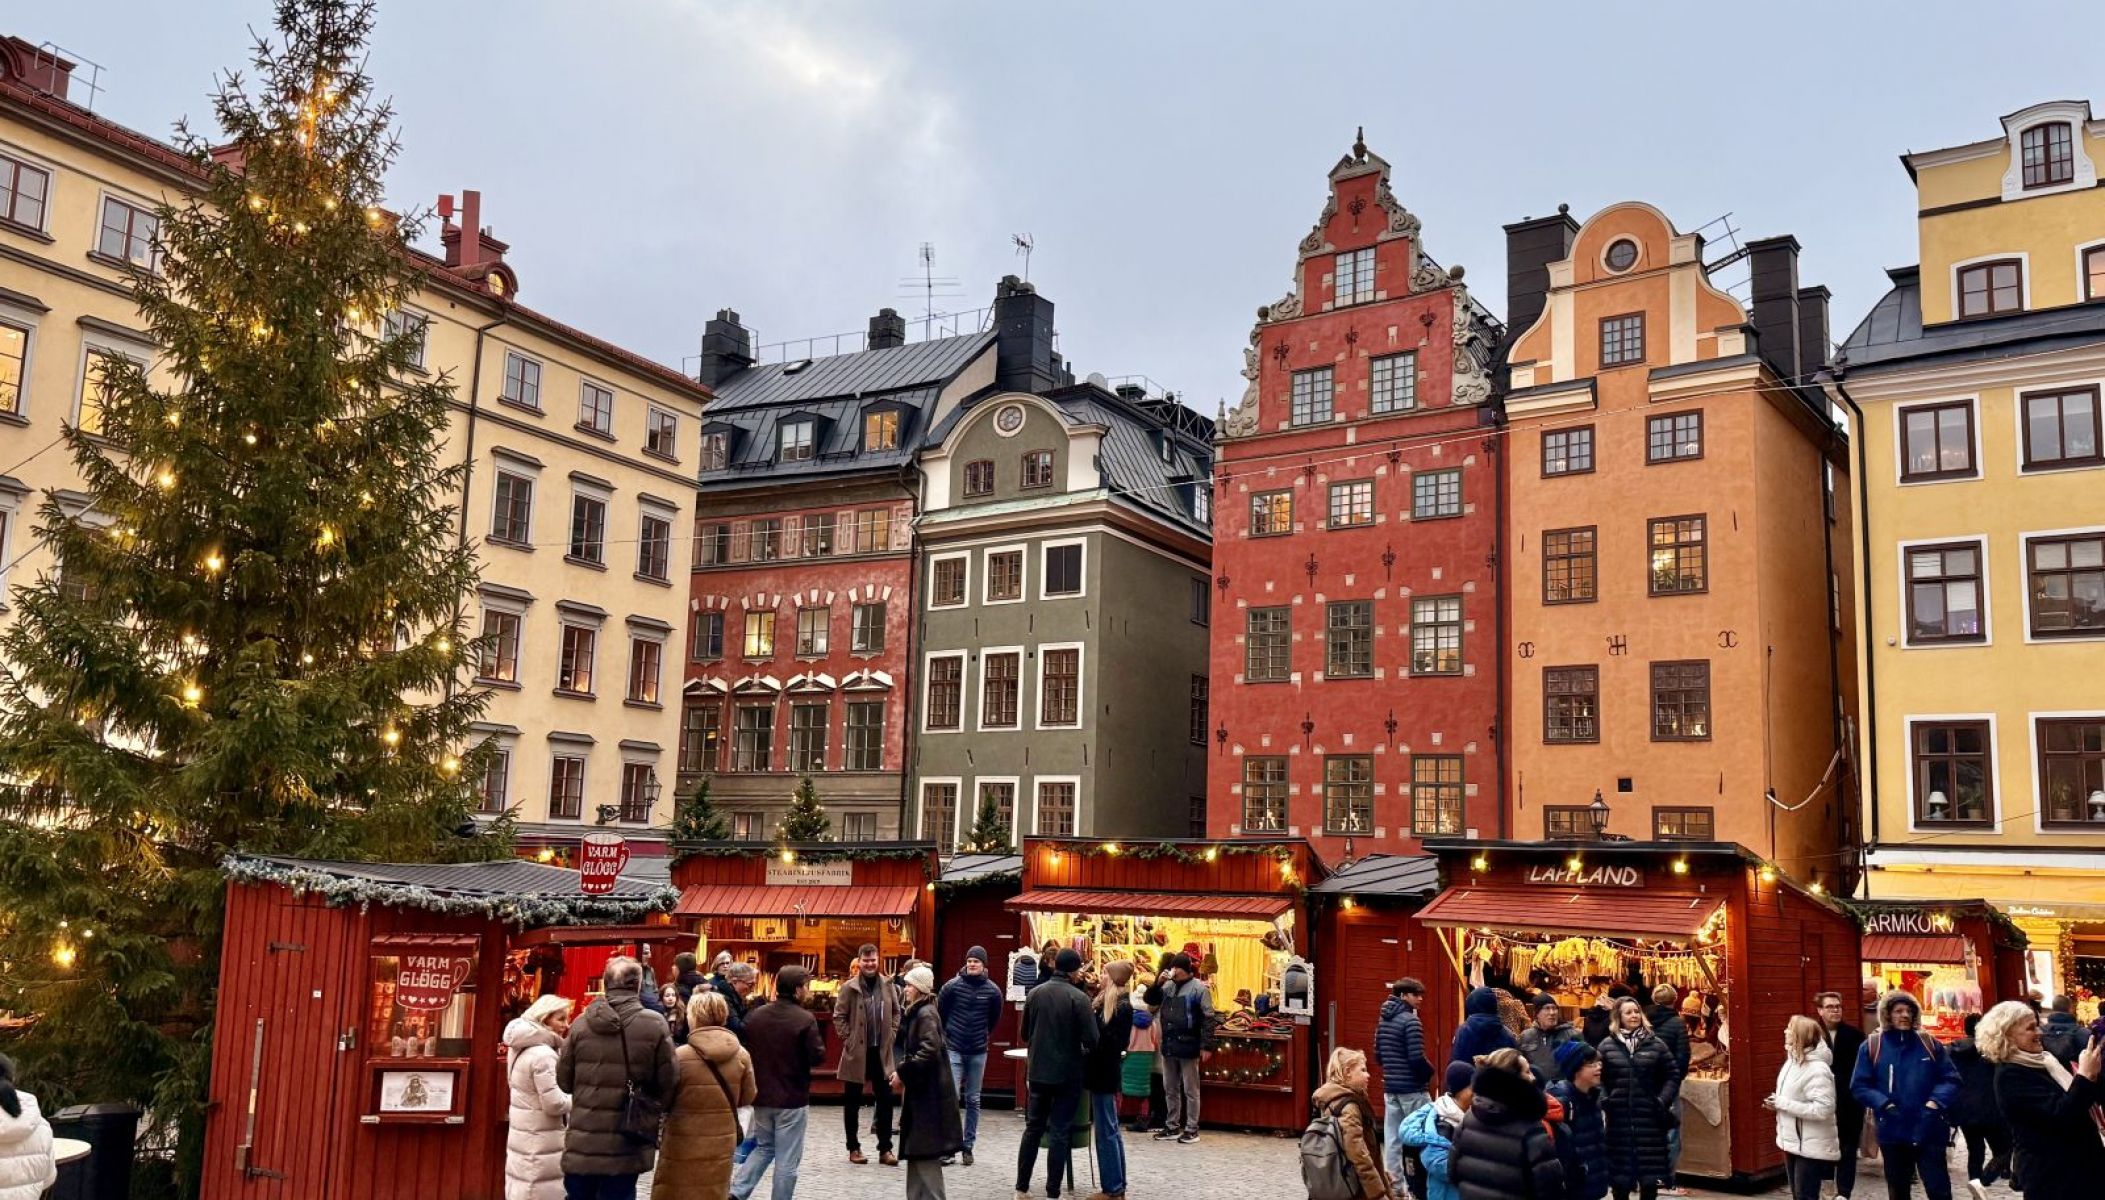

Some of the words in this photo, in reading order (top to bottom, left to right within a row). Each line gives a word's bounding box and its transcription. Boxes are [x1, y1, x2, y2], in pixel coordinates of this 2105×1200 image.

[588, 846, 618, 858] VARM
[583, 859, 618, 876] GLÖGG
[1867, 913, 1955, 934] ARMKORV
[407, 956, 450, 970] VARM
[400, 969, 451, 989] GLÖGG
